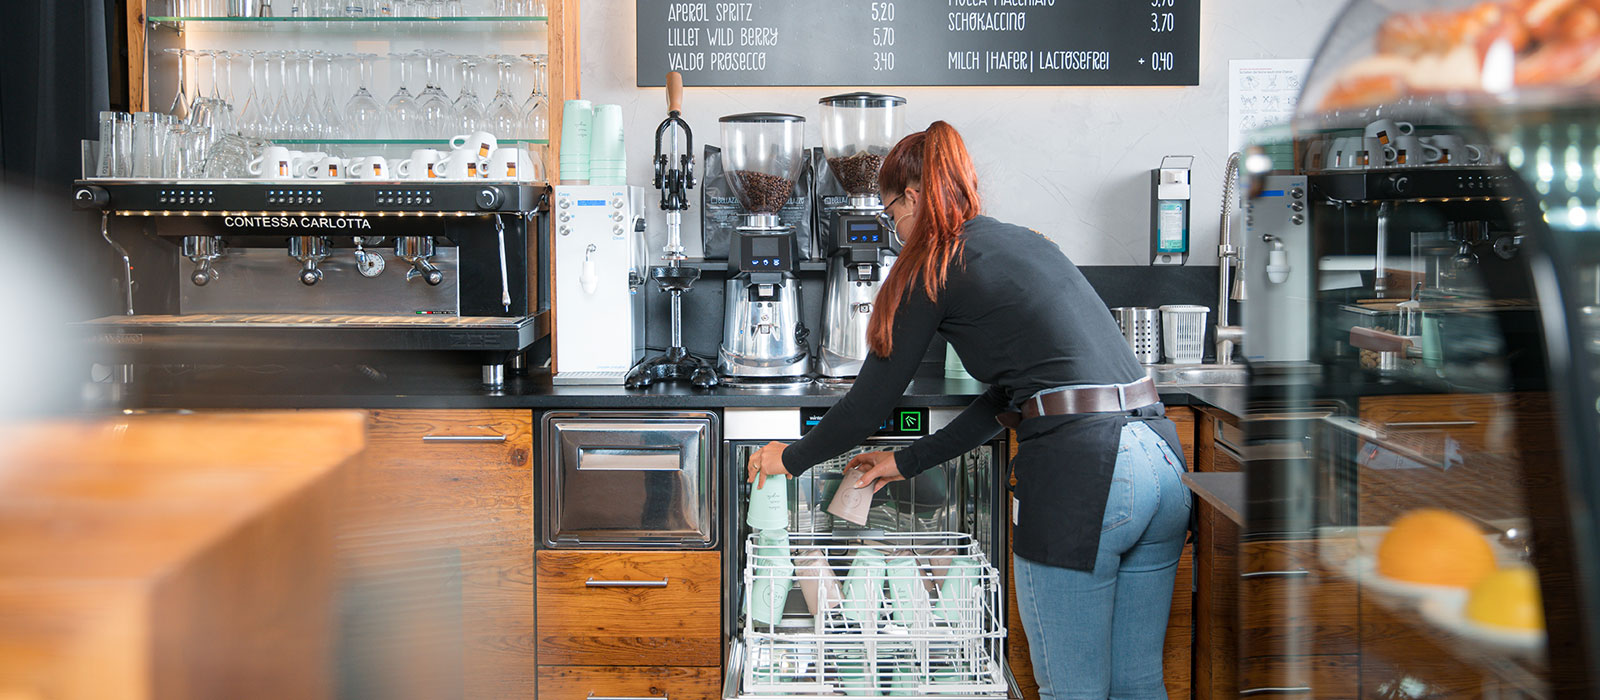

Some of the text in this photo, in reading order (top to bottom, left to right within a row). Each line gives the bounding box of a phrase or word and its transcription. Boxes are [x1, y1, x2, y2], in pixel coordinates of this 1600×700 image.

[667, 3, 753, 22] APEROL SPRITZ
[948, 12, 1026, 31] SCHOKACCINO
[668, 28, 778, 46] LILLET WILD BERRY
[668, 52, 766, 71] VALDO PROSECCO
[948, 52, 980, 70] MILCH
[1039, 52, 1110, 71] LACTOSEFREI
[224, 216, 371, 229] CONTESSA CARLOTTA
